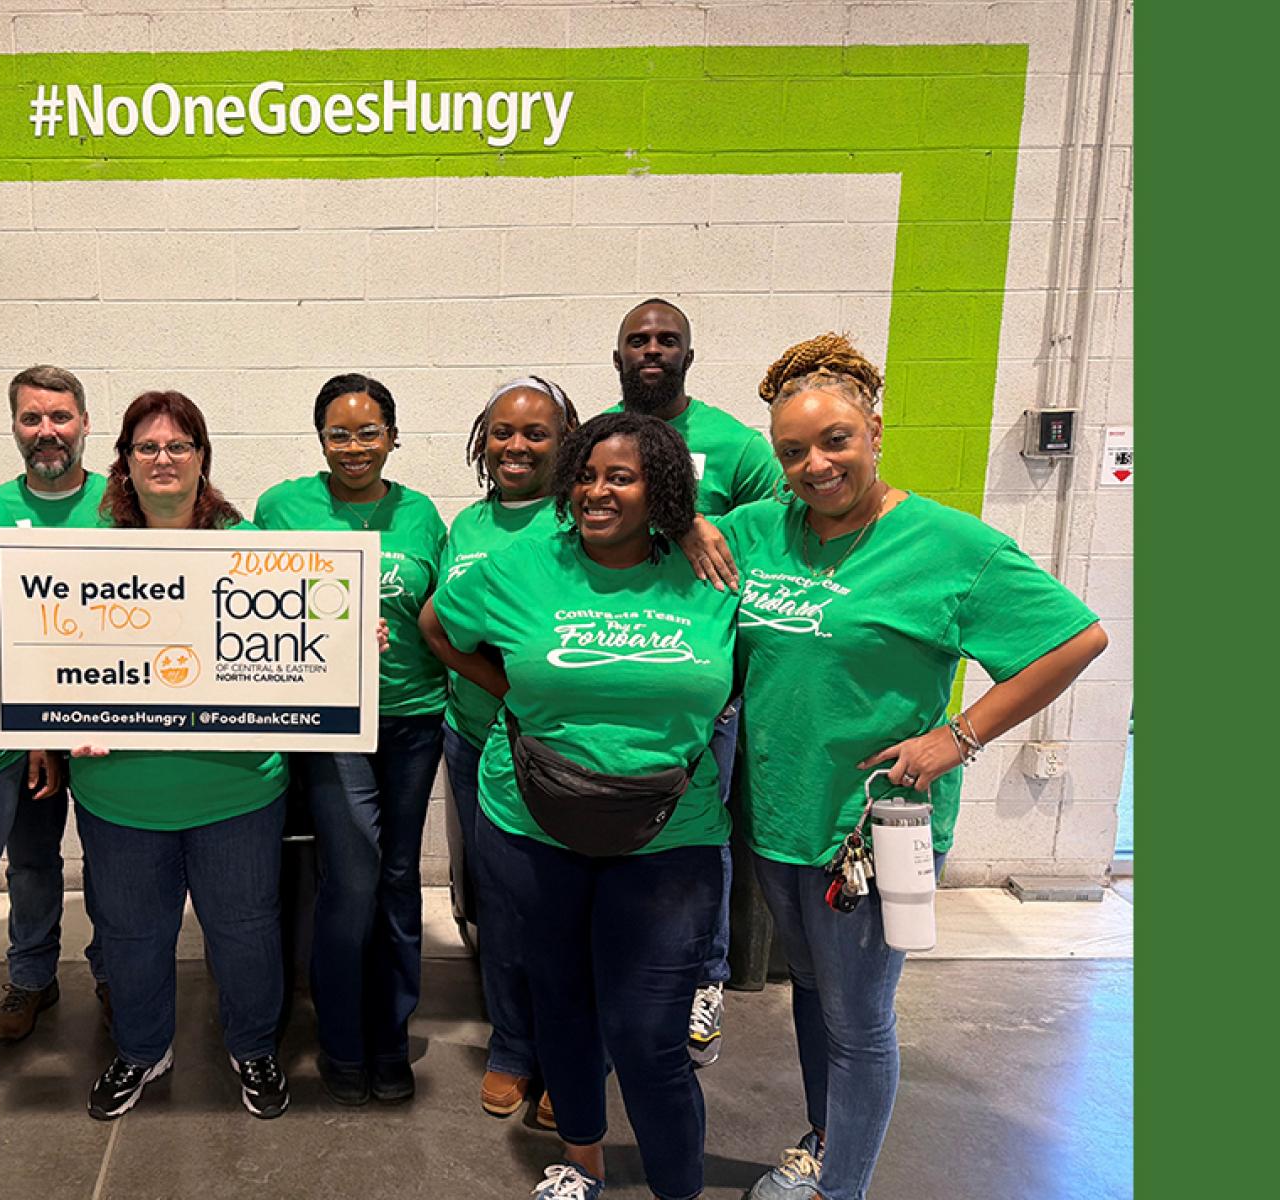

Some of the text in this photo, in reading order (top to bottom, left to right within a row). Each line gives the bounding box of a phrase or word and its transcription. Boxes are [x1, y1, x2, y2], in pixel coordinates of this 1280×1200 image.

[29, 79, 573, 147] #NoOneGoesHungry
[228, 551, 336, 576] 20,000 lbs
[20, 574, 185, 606] We packed
[212, 577, 306, 620] food
[216, 621, 326, 662] bank
[554, 619, 686, 648] Forward
[56, 660, 151, 685] meals!
[216, 664, 328, 674] OF CENTRAL & EASTERN
[216, 674, 304, 682] NORTH CAROLINA
[41, 711, 321, 726] #NoOneGoesHungry @FoodBankCENC
